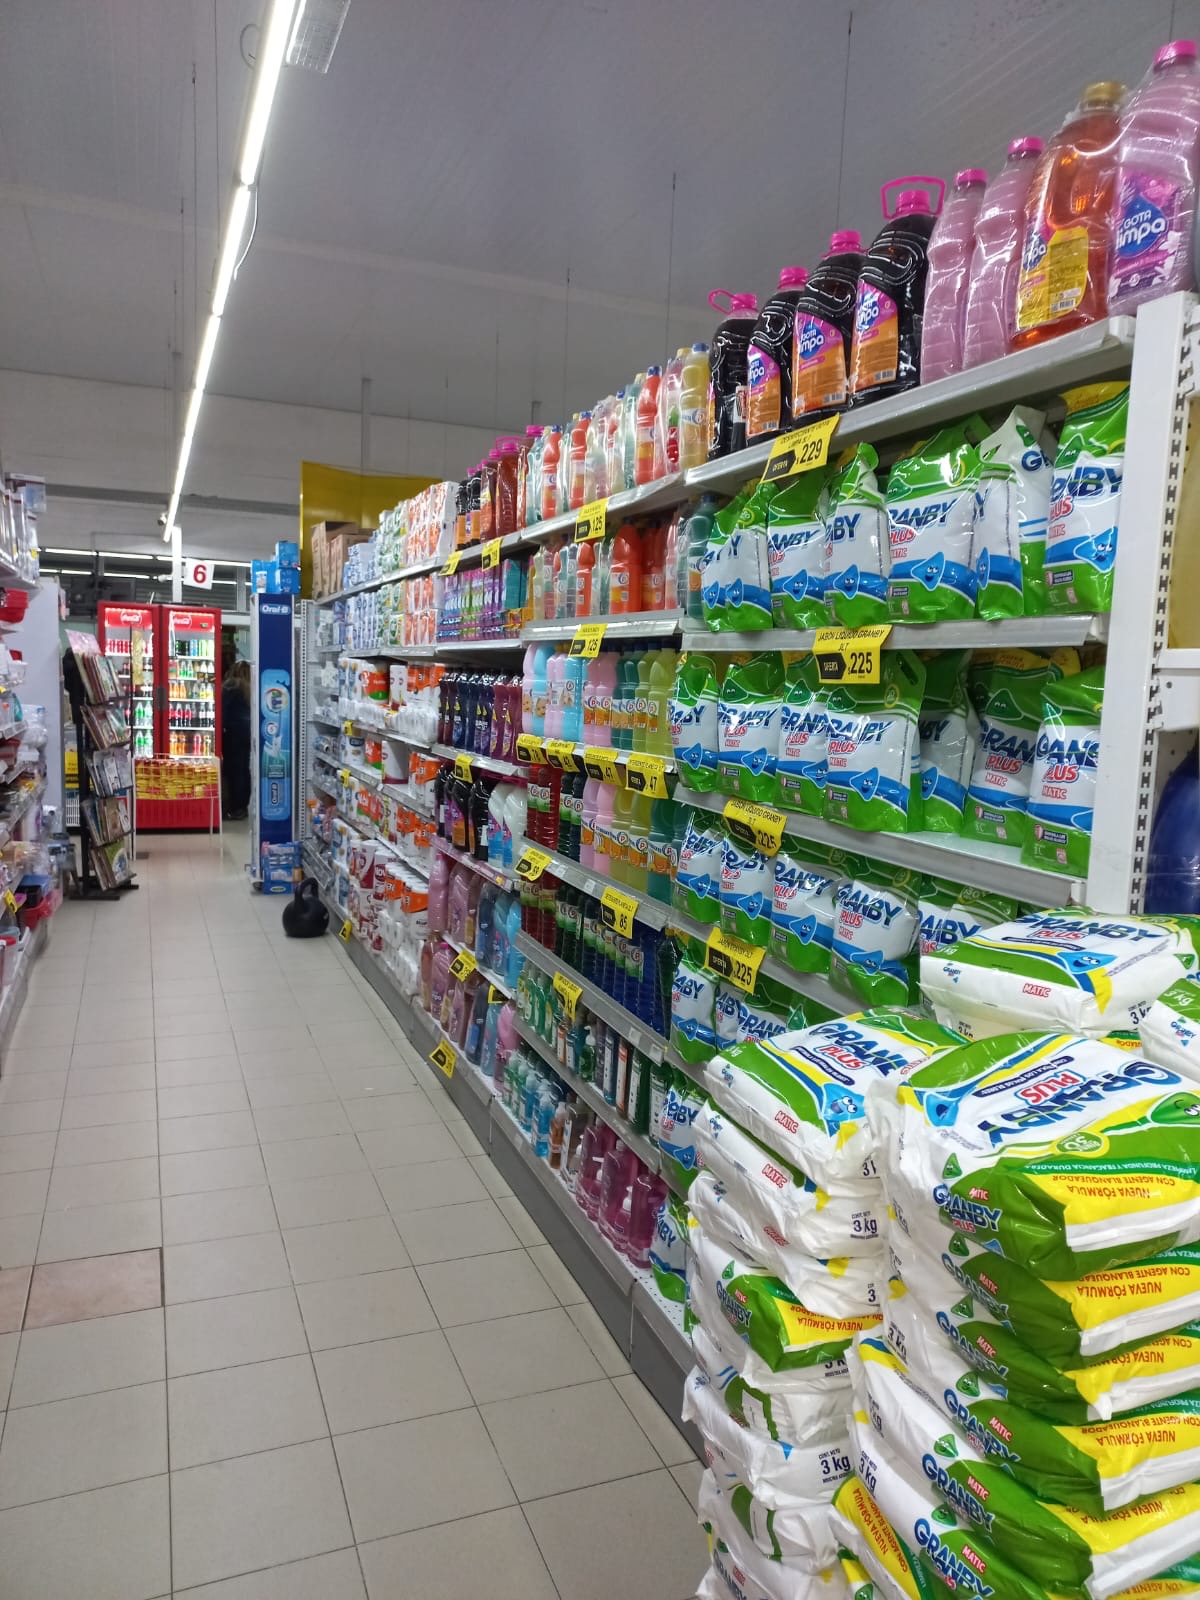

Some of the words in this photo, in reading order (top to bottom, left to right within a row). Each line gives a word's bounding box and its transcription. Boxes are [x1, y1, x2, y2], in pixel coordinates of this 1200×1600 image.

[1123, 210, 1152, 228] GOTA
[1116, 218, 1167, 249] limpa
[889, 499, 958, 528] RANBY
[1049, 496, 1074, 520] LUS
[768, 528, 821, 550] ANBY
[769, 552, 786, 565] LUS
[193, 564, 207, 584] 6
[261, 604, 289, 615] Oral-B
[823, 661, 839, 673] OFERTA
[828, 741, 858, 753] PLUS
[986, 755, 1022, 772] PLUS
[984, 772, 1009, 787] MATIC
[1042, 785, 1068, 799] MATIC
[774, 861, 834, 896] RANBY
[774, 884, 797, 899] PLUS
[841, 910, 864, 928] PLUS
[1016, 914, 1166, 942] GRANBY
[1034, 930, 1085, 941] PLUS
[1022, 983, 1051, 998] MATIC
[1164, 989, 1175, 998] 3
[1175, 991, 1195, 1006] kg
[1130, 1011, 1140, 1025] 3
[808, 1022, 909, 1077] GRAN
[820, 1044, 866, 1069] PLUS
[1020, 1073, 1081, 1104] PLUS
[976, 1060, 1185, 1147] GRANBY
[774, 1110, 800, 1135] MATIC
[863, 1162, 871, 1177] 3
[1052, 1174, 1122, 1184] BLANQUEADOR
[1123, 1176, 1155, 1185] AGENTE
[1156, 1177, 1176, 1187] CON
[1067, 1184, 1116, 1200] FÓRMULA
[1117, 1186, 1150, 1199] NUEVA
[853, 1219, 863, 1232] 3
[864, 1216, 878, 1234] kg
[1080, 1270, 1134, 1282] BLANQUEA
[1136, 1266, 1168, 1278] AGENTE
[1169, 1266, 1190, 1276] CON
[978, 1272, 999, 1296] MATIC
[1077, 1284, 1127, 1299] FÓRMULA
[1129, 1282, 1162, 1296] NUEVA
[716, 1280, 752, 1327] GRANBY
[867, 1288, 876, 1303] 3
[797, 1317, 835, 1330] FÓRMULA
[836, 1321, 863, 1332] NUEVA
[976, 1335, 997, 1359] MATIC
[1172, 1338, 1192, 1348] CON
[1134, 1352, 1164, 1364] NUEVA
[988, 1416, 1014, 1443] MATIC
[1146, 1430, 1176, 1443] NUEVA
[1096, 1432, 1145, 1447] FÓRMULA
[820, 1459, 831, 1475] 3
[832, 1455, 851, 1472] kg
[858, 1457, 865, 1474] 3
[865, 1465, 877, 1493] kg
[921, 1453, 996, 1533] GRANBY
[966, 1475, 990, 1503] MATIC
[1134, 1500, 1164, 1516] NUEVA
[869, 1523, 888, 1556] NUEVA
[883, 1524, 900, 1555] AGENTE
[895, 1552, 908, 1573] CON
[914, 1517, 996, 1598] GRANBY
[960, 1544, 988, 1575] MATIC
